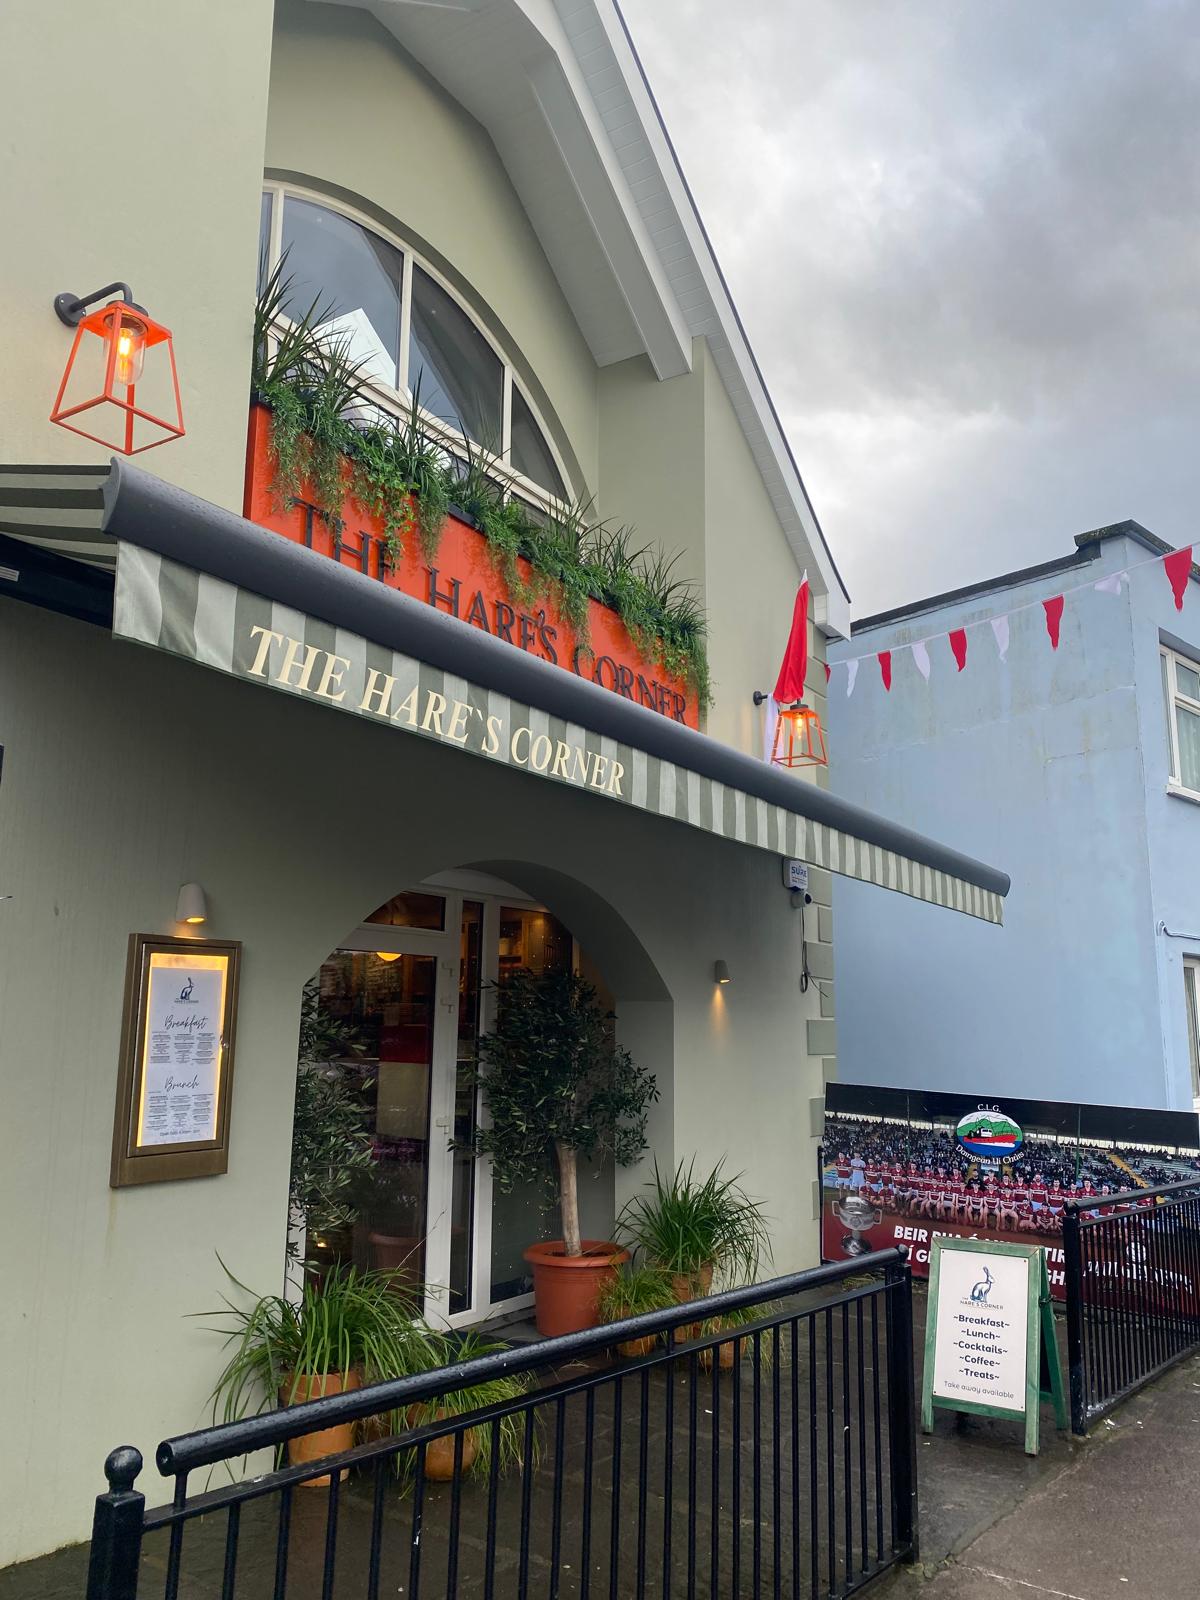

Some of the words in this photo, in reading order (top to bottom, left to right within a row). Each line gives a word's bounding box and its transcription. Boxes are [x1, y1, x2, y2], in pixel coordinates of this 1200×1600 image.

[247, 625, 351, 702] THE
[511, 727, 625, 796] CORNER
[164, 1014, 209, 1033] Breakfast
[164, 1074, 200, 1092] Brunch
[893, 1225, 928, 1243] BEIR
[944, 1380, 960, 1390] Take
[961, 1385, 981, 1394] away
[982, 1388, 1015, 1399] available
